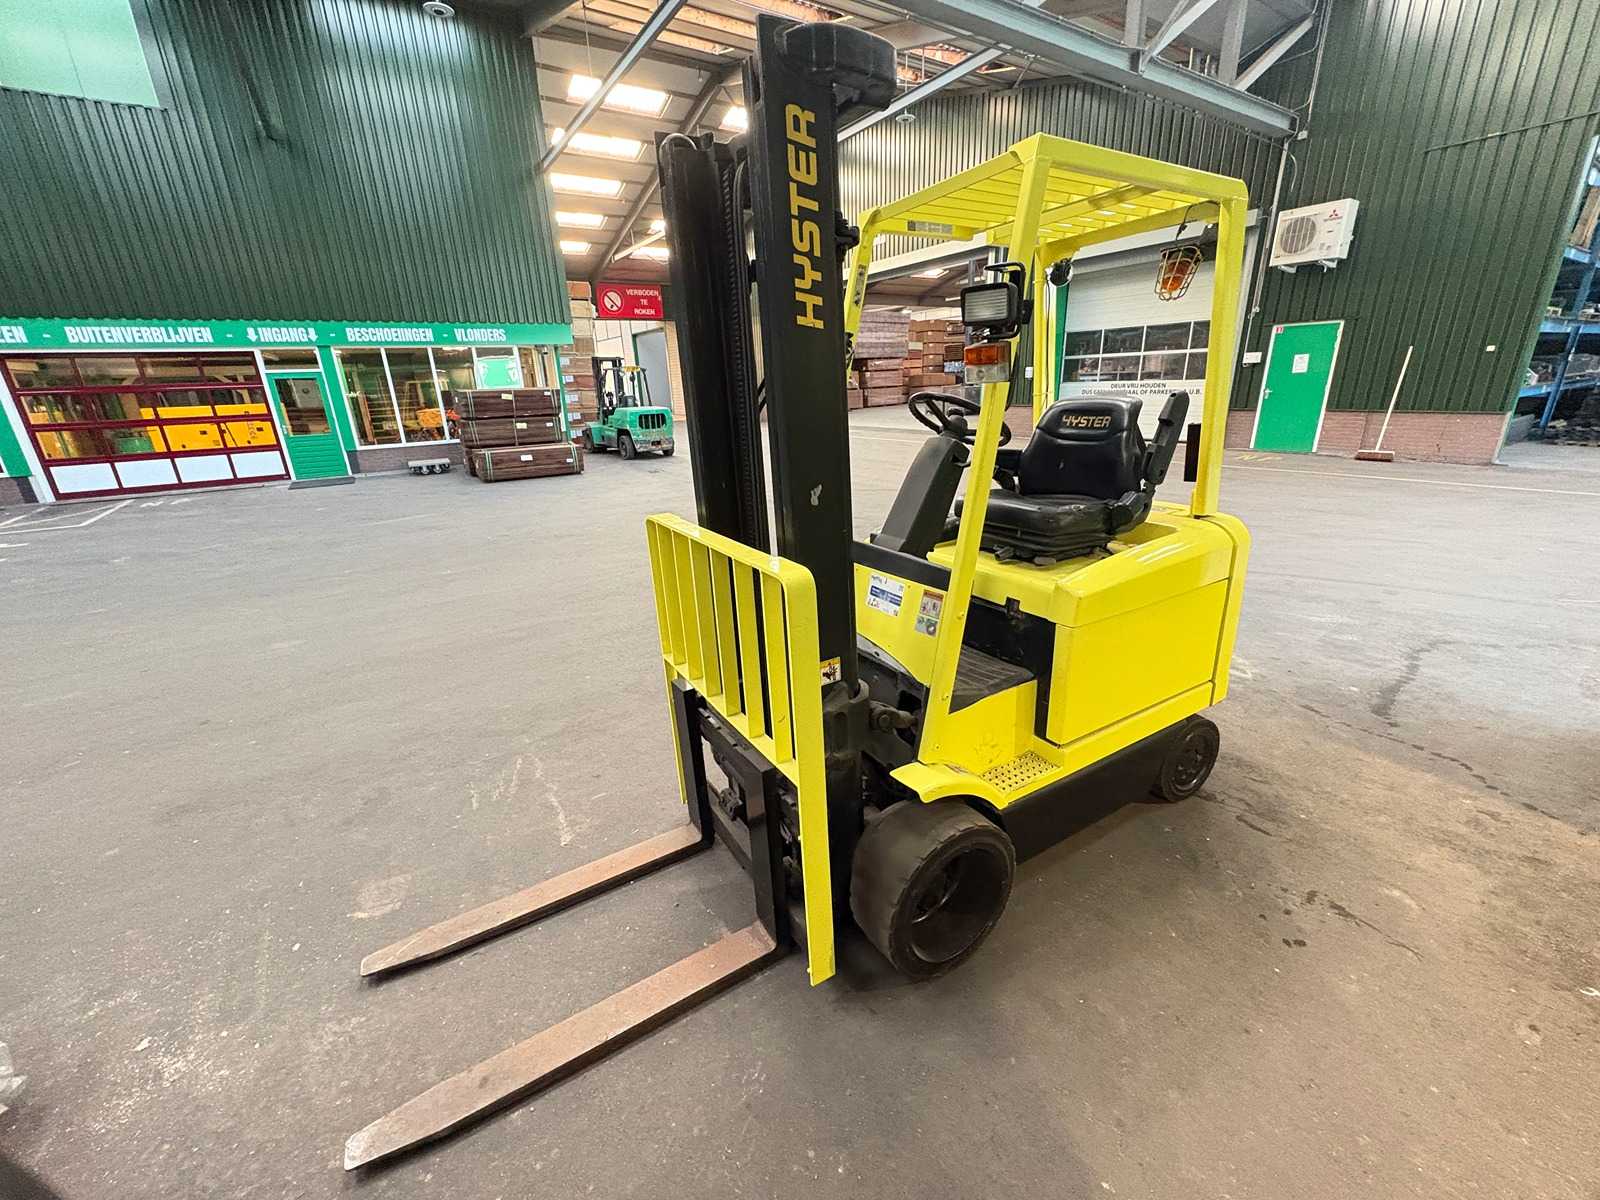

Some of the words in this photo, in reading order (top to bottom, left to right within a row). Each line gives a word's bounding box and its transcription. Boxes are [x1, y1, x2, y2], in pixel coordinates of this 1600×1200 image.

[785, 103, 825, 330] HYSTER
[625, 288, 659, 297] VERBODEN
[634, 308, 656, 316] ROKEN
[63, 325, 214, 344] BUITENVERBLIJVEN
[257, 326, 309, 343] INGANG
[345, 327, 435, 342] BESCHOEIINGEN
[453, 327, 507, 342] VLONDERS
